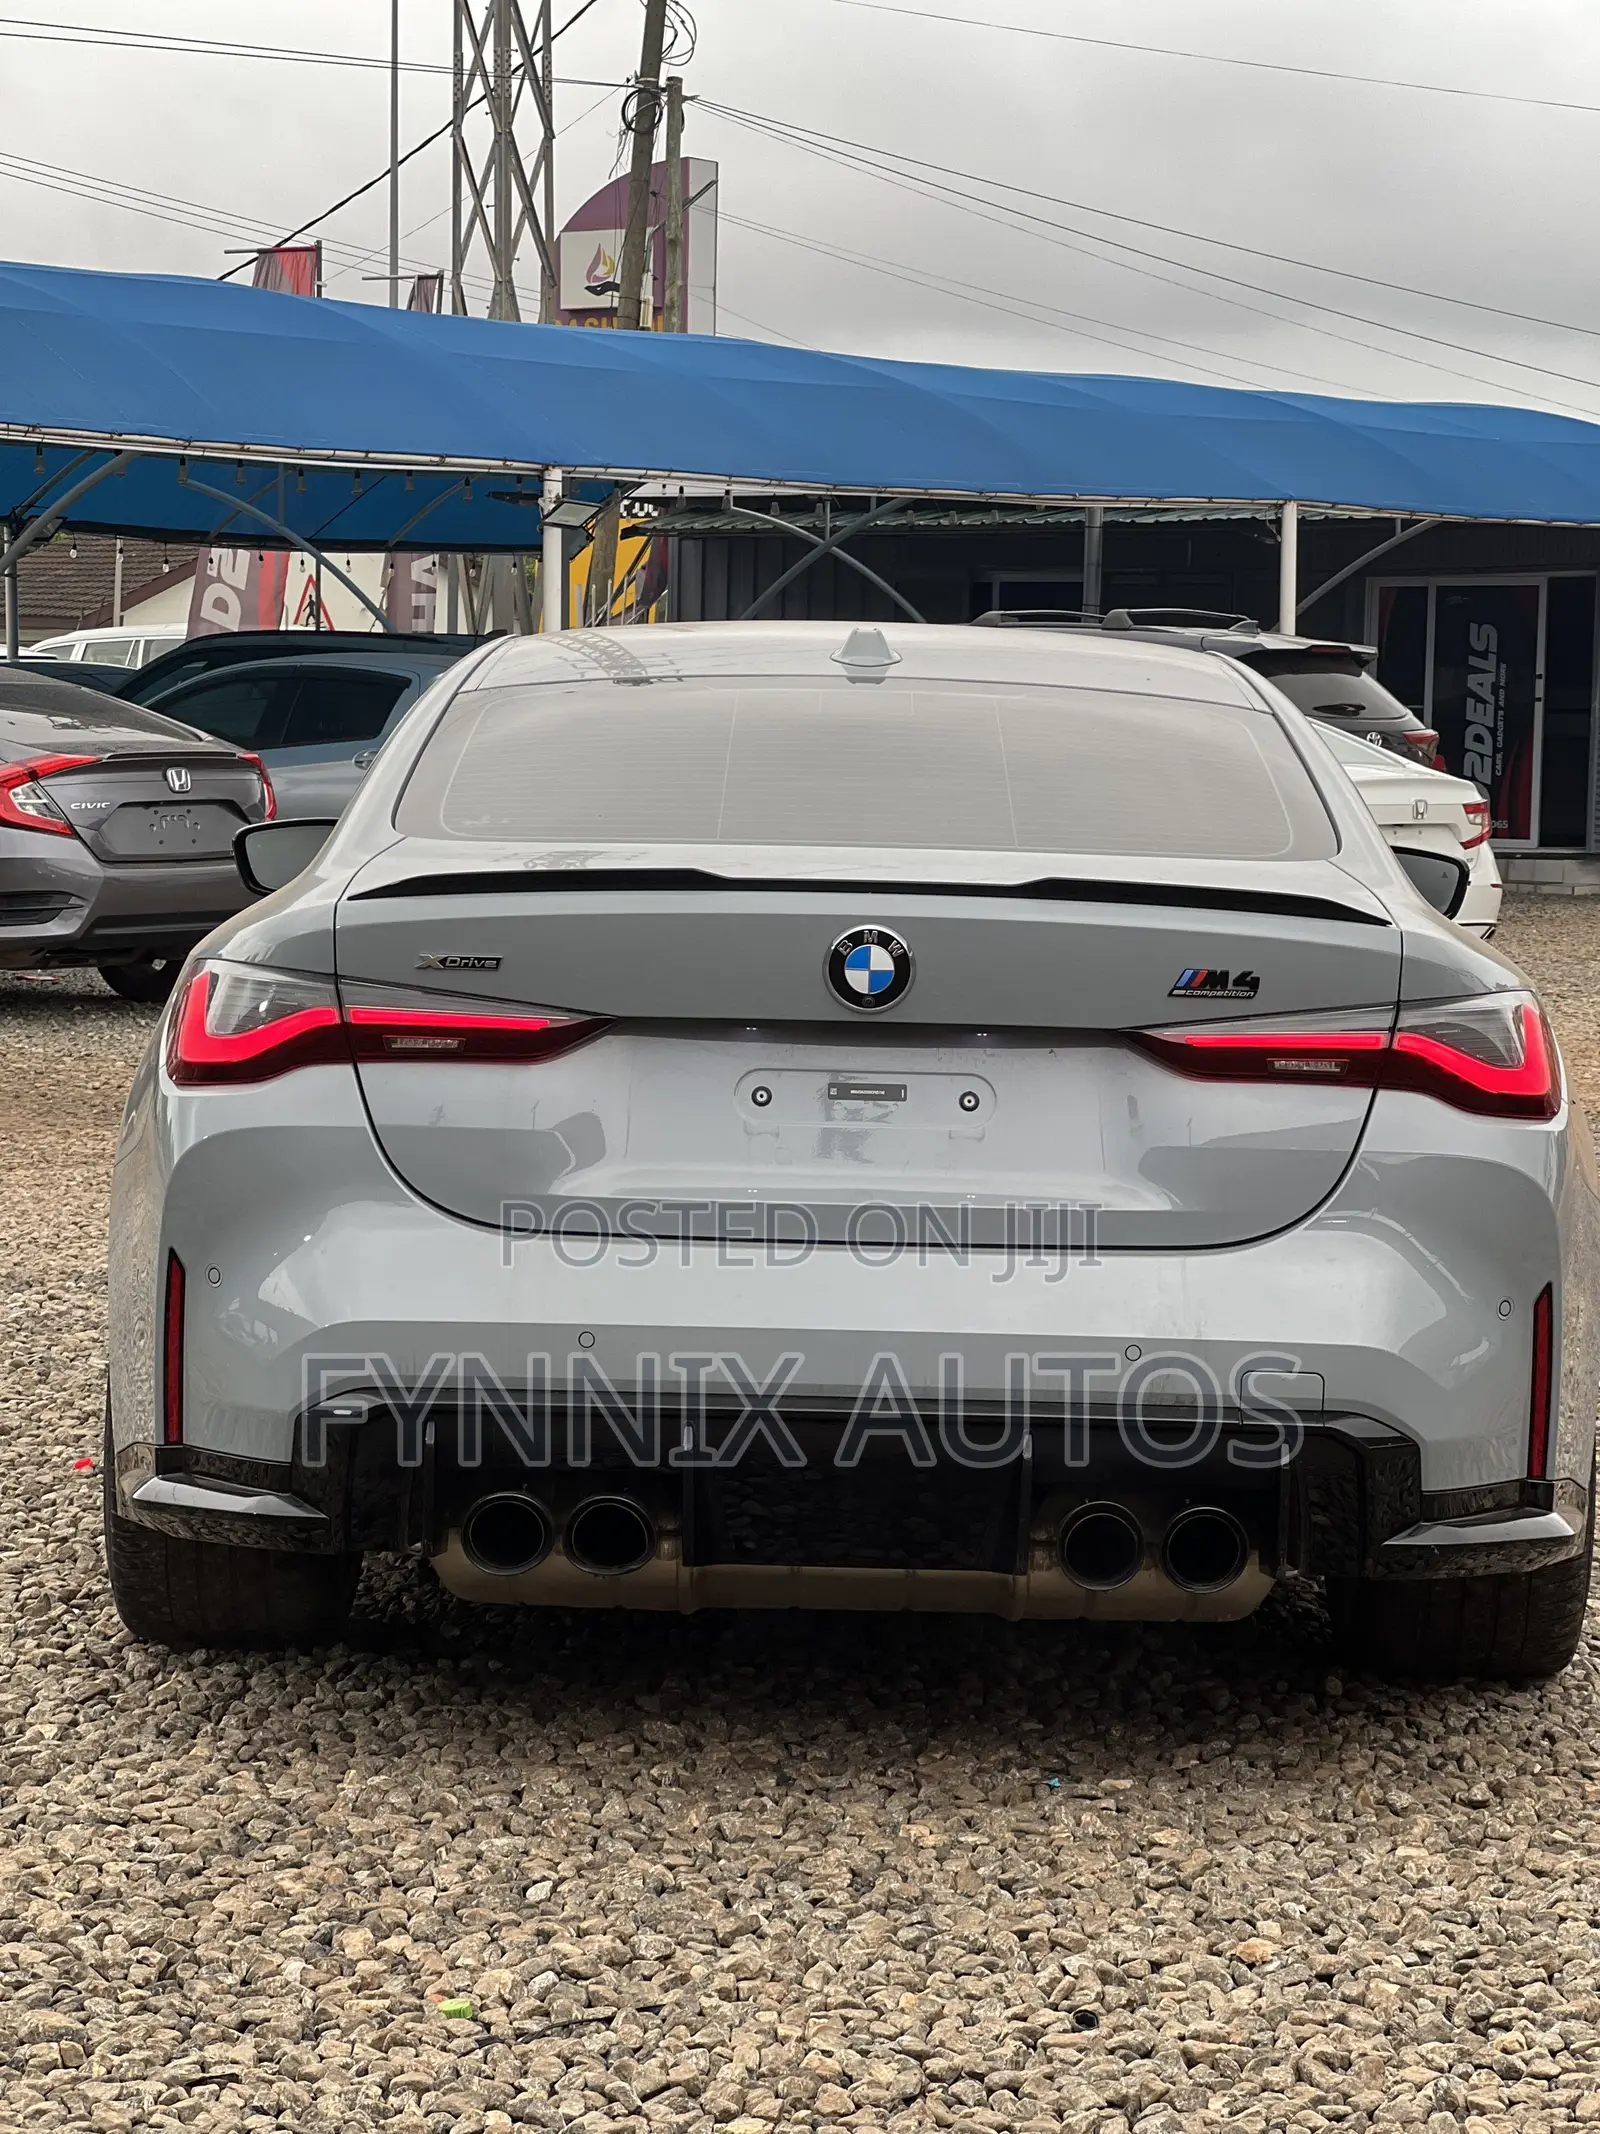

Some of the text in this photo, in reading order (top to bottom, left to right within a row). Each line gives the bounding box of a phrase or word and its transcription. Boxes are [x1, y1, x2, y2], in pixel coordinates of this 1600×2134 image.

[1498, 688, 1506, 708] AND
[1463, 622, 1498, 800] 2DEALS
[70, 802, 110, 810] CIVIC
[837, 930, 904, 957] BMW
